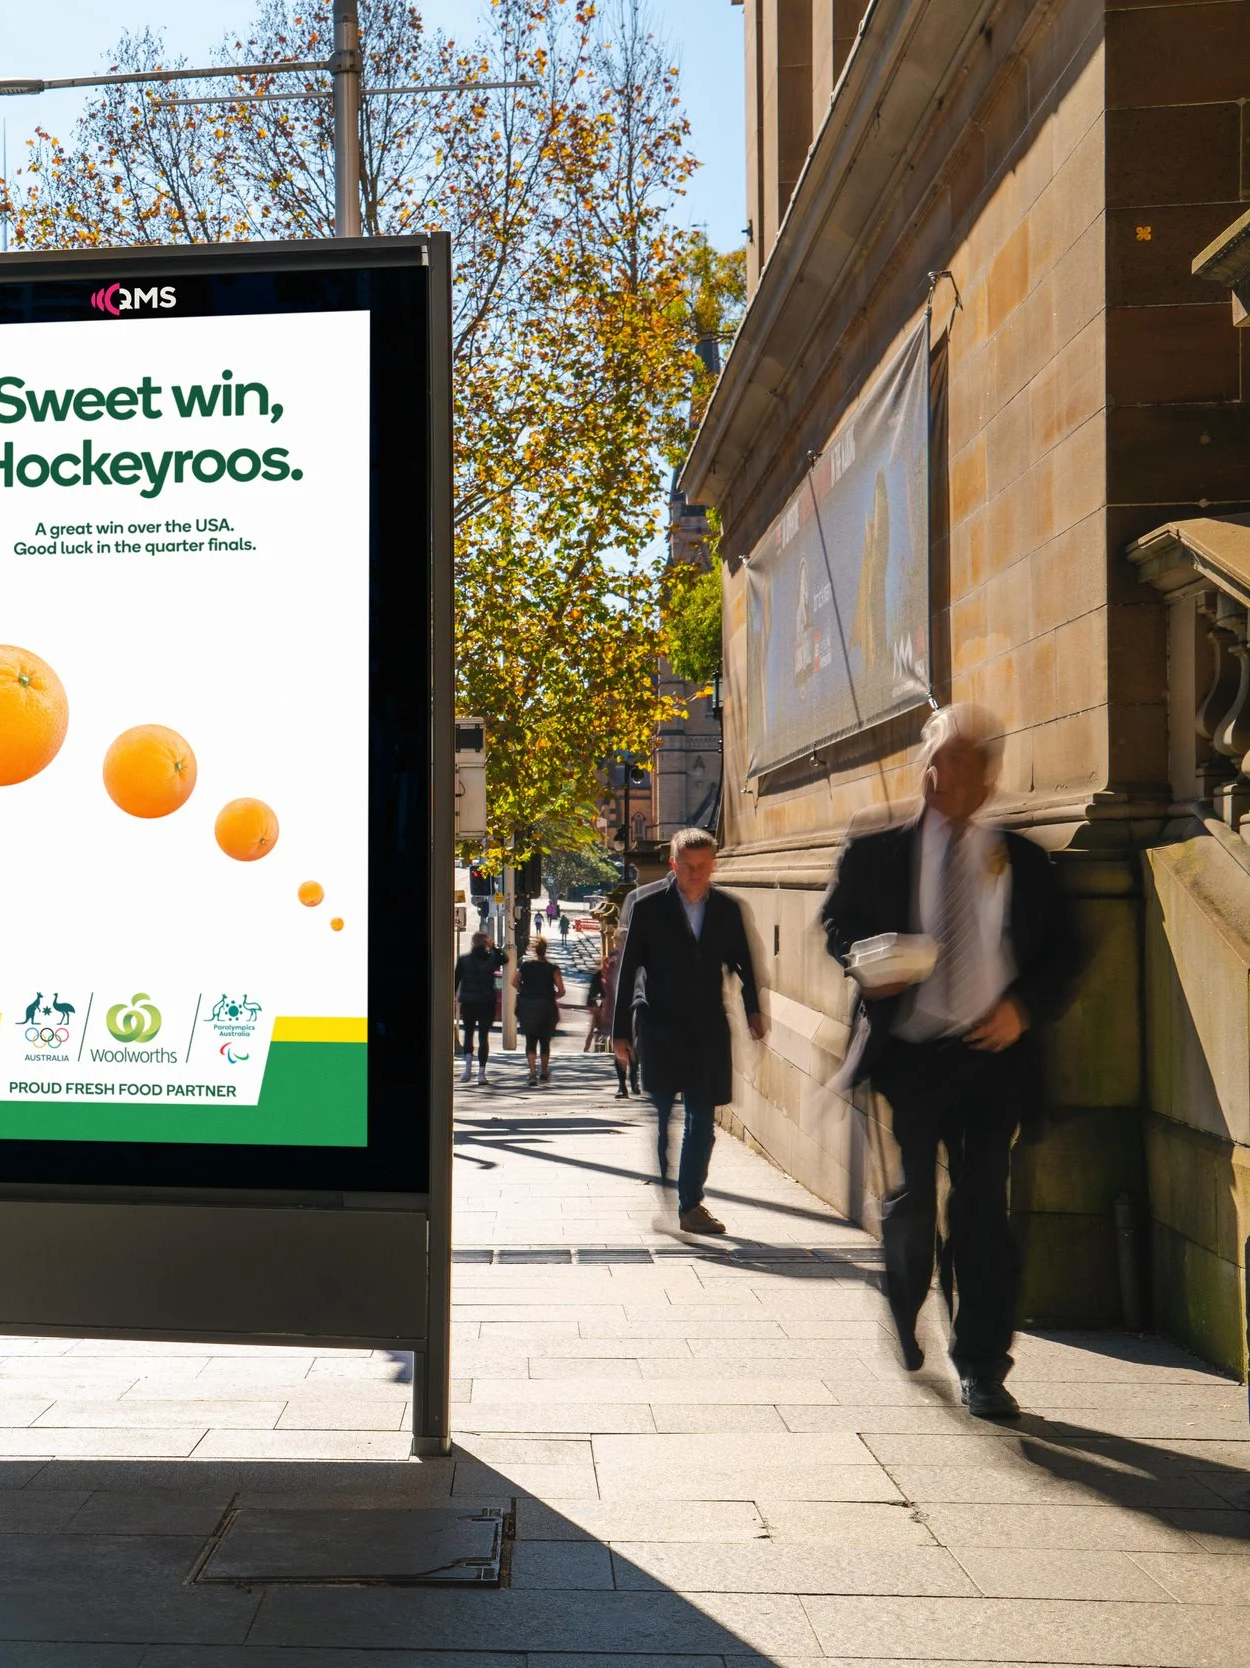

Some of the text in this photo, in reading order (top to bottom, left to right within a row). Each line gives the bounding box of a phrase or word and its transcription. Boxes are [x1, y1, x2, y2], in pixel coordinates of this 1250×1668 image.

[105, 283, 177, 316] QMS
[170, 369, 284, 424] win,
[35, 518, 235, 539] A great win over the USA.
[14, 537, 257, 556] Good luck in the quarter finals.
[213, 1024, 256, 1032] Paralympics
[219, 1030, 251, 1038] Australia
[24, 1053, 70, 1062] AUSTRALIA
[90, 1047, 178, 1064] Woolworths
[9, 1081, 237, 1098] PROUD FRESH FOOD PARTNER
